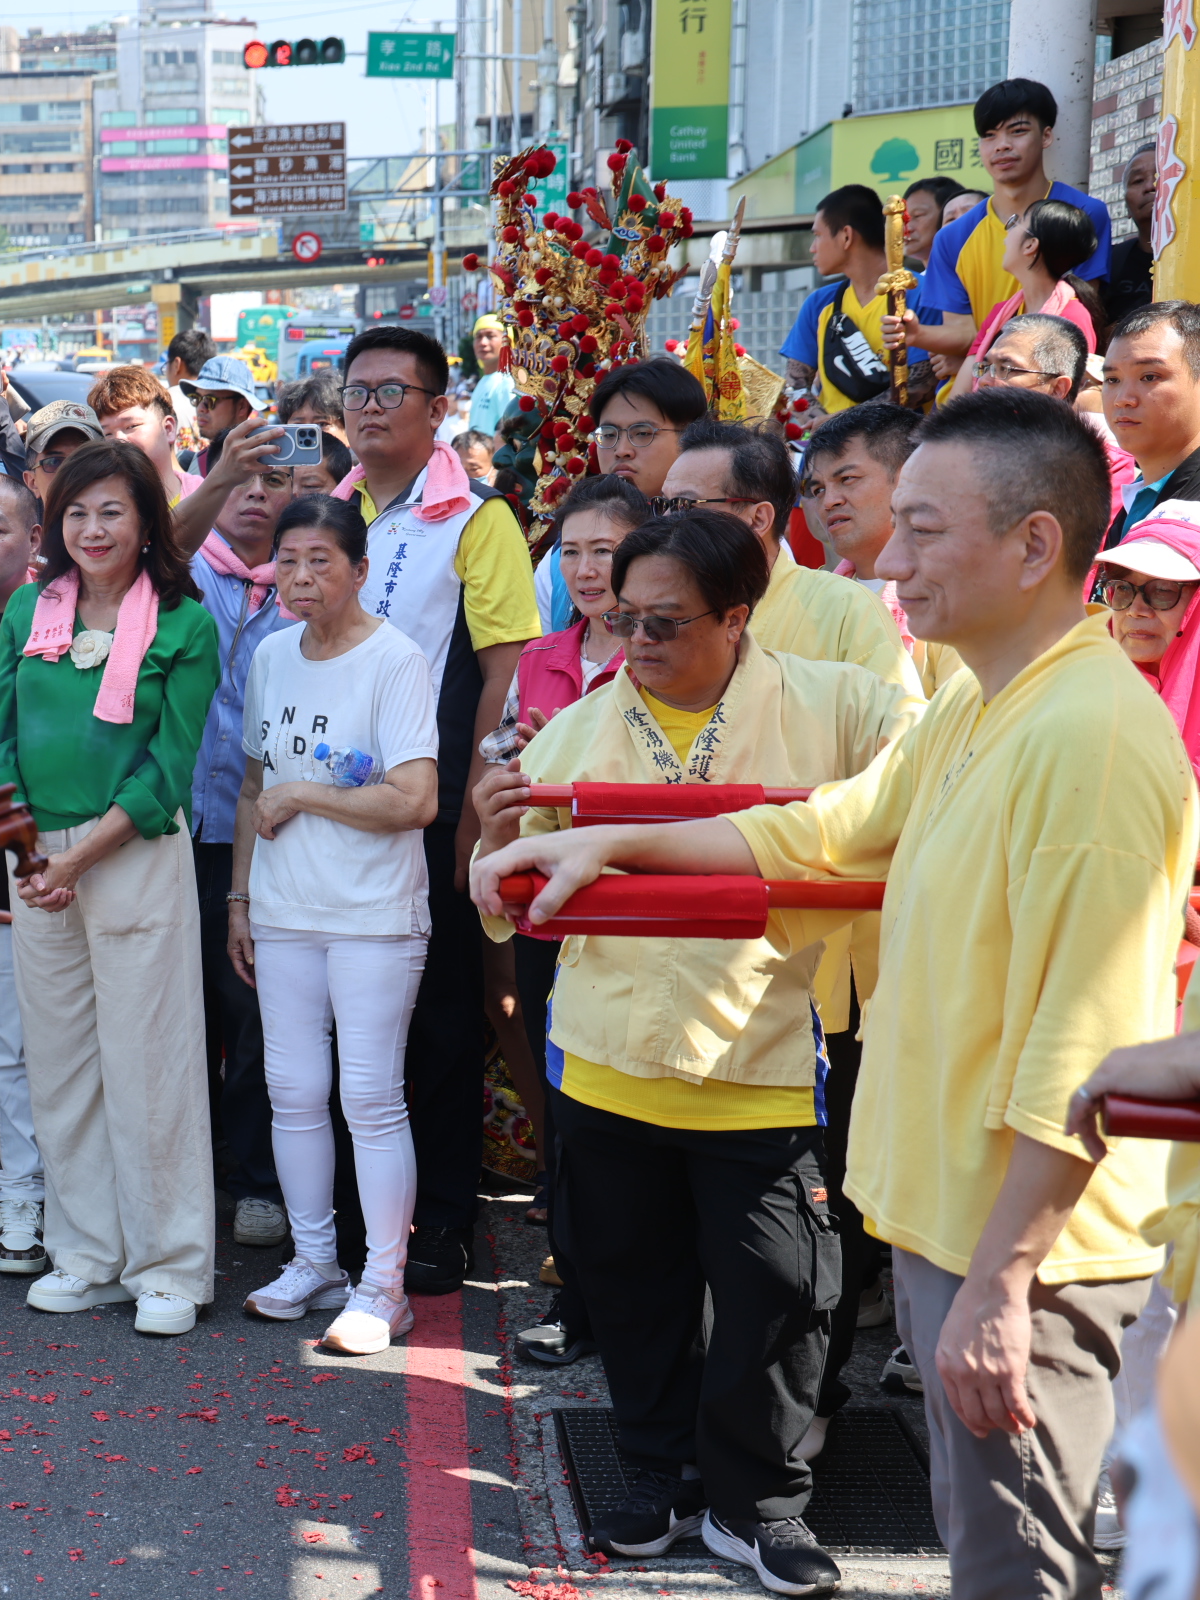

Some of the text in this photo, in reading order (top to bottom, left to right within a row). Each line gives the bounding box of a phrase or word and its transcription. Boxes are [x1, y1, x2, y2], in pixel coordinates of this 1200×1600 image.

[680, 0, 707, 34] 行
[380, 39, 442, 57] 孝二路
[379, 61, 401, 72] Xiao
[403, 61, 423, 72] 2nd
[253, 124, 343, 143] 正濱漁港色彩屋
[670, 125, 707, 138] Cathay
[263, 143, 298, 153] Colorful
[670, 138, 706, 150] United
[254, 154, 343, 173] 碧砂漁港
[670, 152, 697, 163] Bank
[254, 186, 343, 203] 海洋科技博物館
[841, 331, 888, 376] NIKE
[376, 542, 408, 618] 基隆市政
[686, 701, 727, 784] 基隆護
